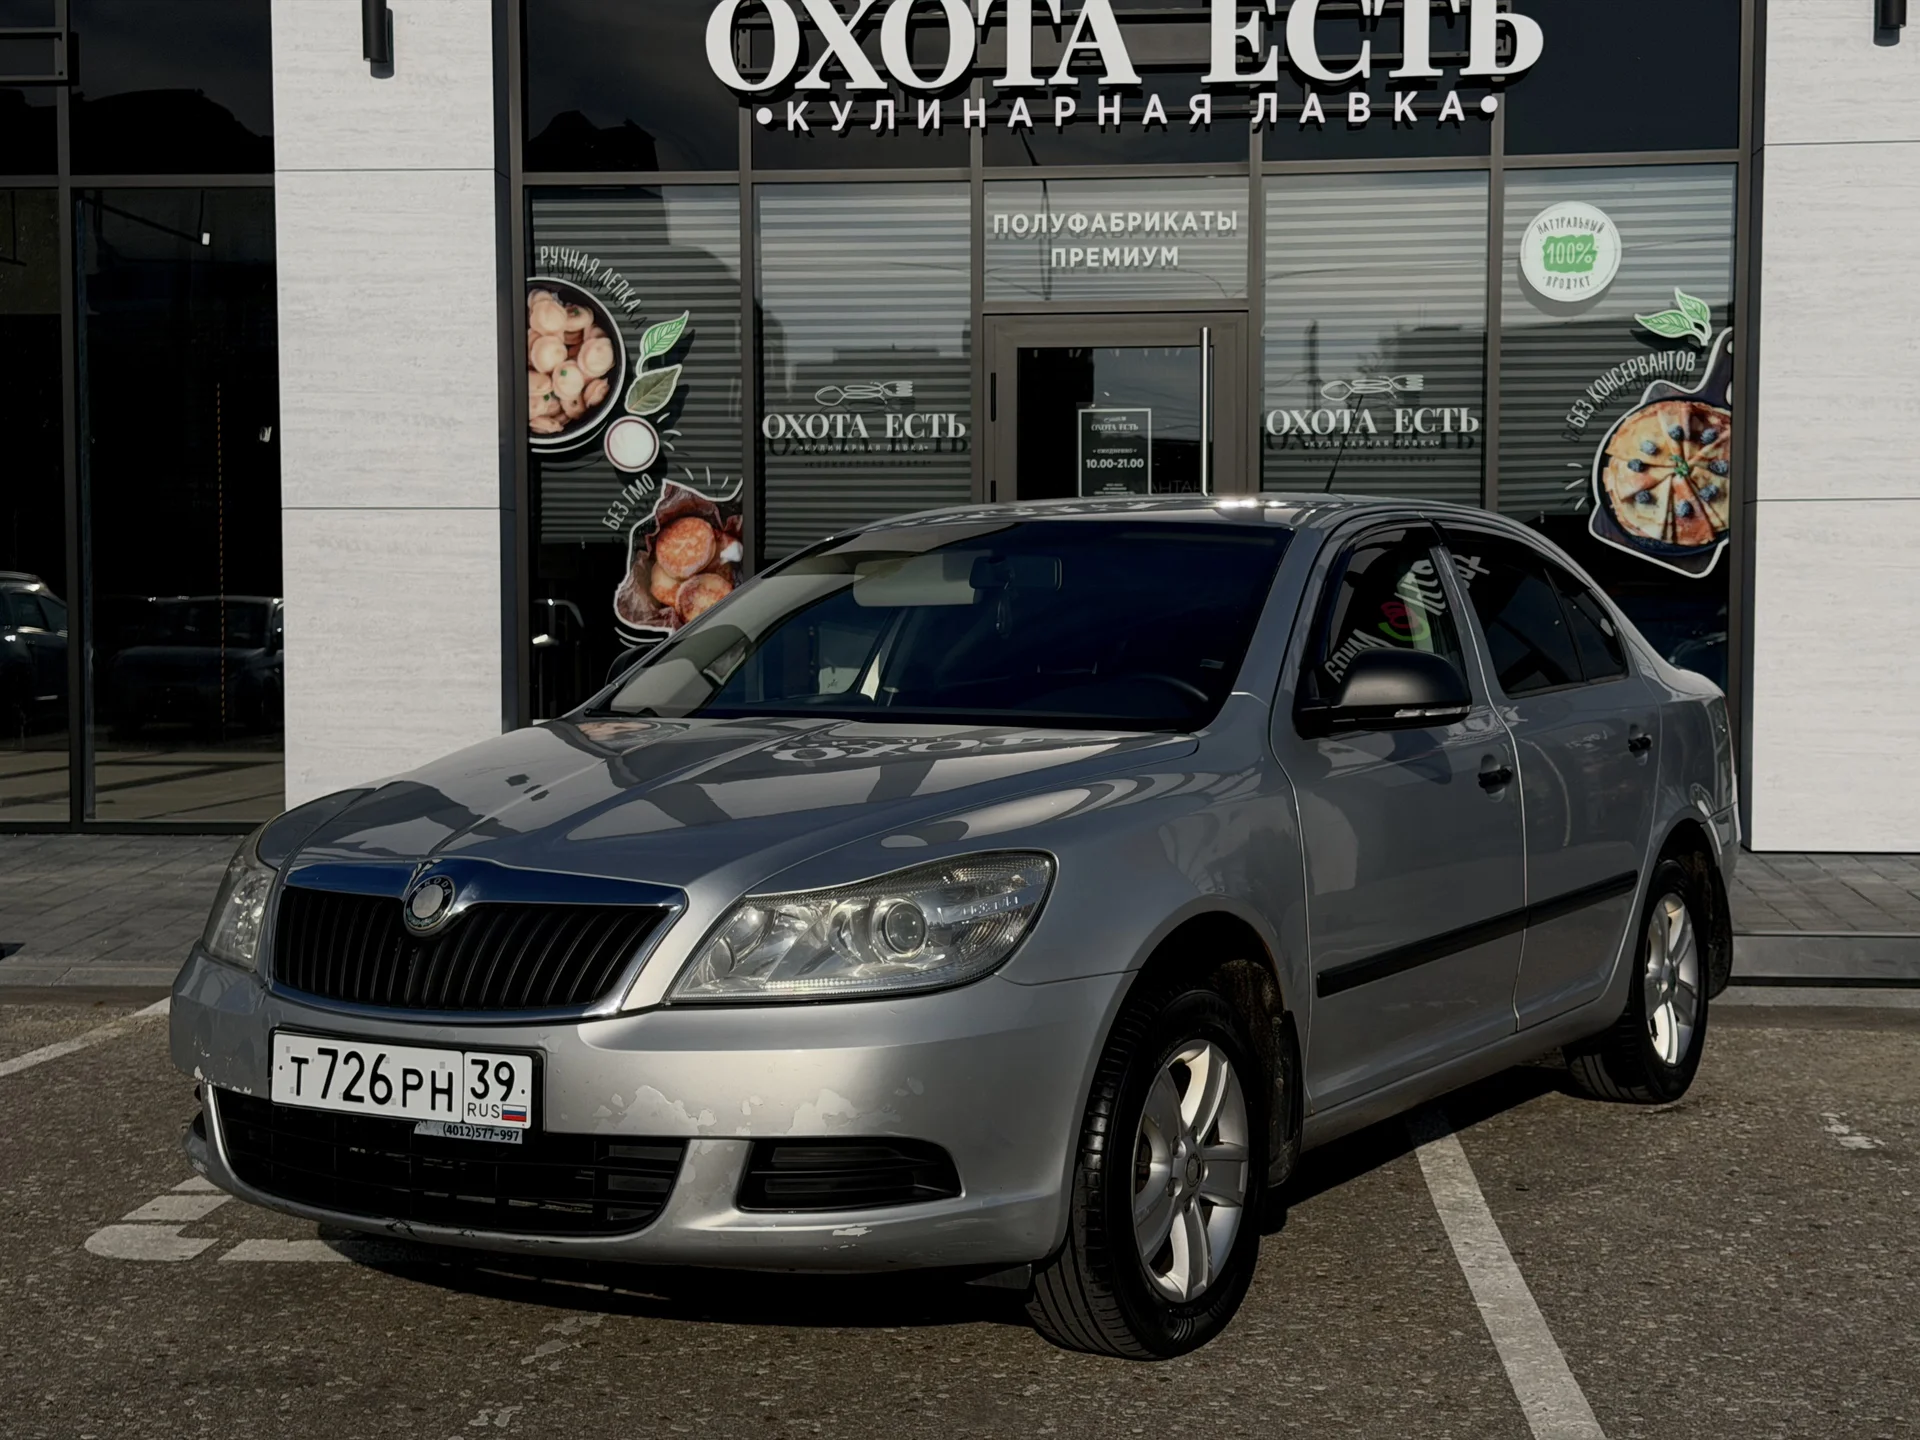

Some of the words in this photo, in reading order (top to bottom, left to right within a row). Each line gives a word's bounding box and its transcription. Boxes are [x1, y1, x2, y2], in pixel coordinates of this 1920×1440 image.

[706, 0, 1141, 91] ОХОТА
[1202, 0, 1544, 83] ЕСТЬ
[787, 94, 1211, 131] КУЛИНАРНАЯ
[1252, 91, 1465, 124] ЛАВКА
[994, 211, 1237, 233] ПОЛУФАБРИКАТЫ
[1536, 216, 1605, 235] НАТУРАЛЬНЫЙ
[1051, 246, 1179, 268] ПРЕМИУМ
[1546, 242, 1593, 265] 100%
[541, 246, 600, 277] РУЧНАЯ
[598, 267, 641, 313] ЛЕПКА
[1546, 276, 1590, 290] ПРОДУКТ
[1566, 399, 1595, 428] БЕЗ
[1586, 350, 1696, 403] КОНСЕРВАНТОВ
[762, 413, 870, 439] ОХОТА
[885, 413, 967, 439] ЕСТЬ
[1266, 408, 1378, 435] ОХОТА
[1393, 407, 1480, 434] ЕСТЬ
[804, 443, 881, 452] КУЛИНАРНАЯ
[1086, 458, 1144, 469] 10.00-21.00
[602, 500, 630, 531] БЕЗ
[621, 472, 655, 505] ГМО
[290, 1046, 454, 1112] Т726РН
[470, 1058, 515, 1102] 39
[467, 1102, 500, 1119] RUS
[442, 1122, 520, 1142] (4012)577-997
